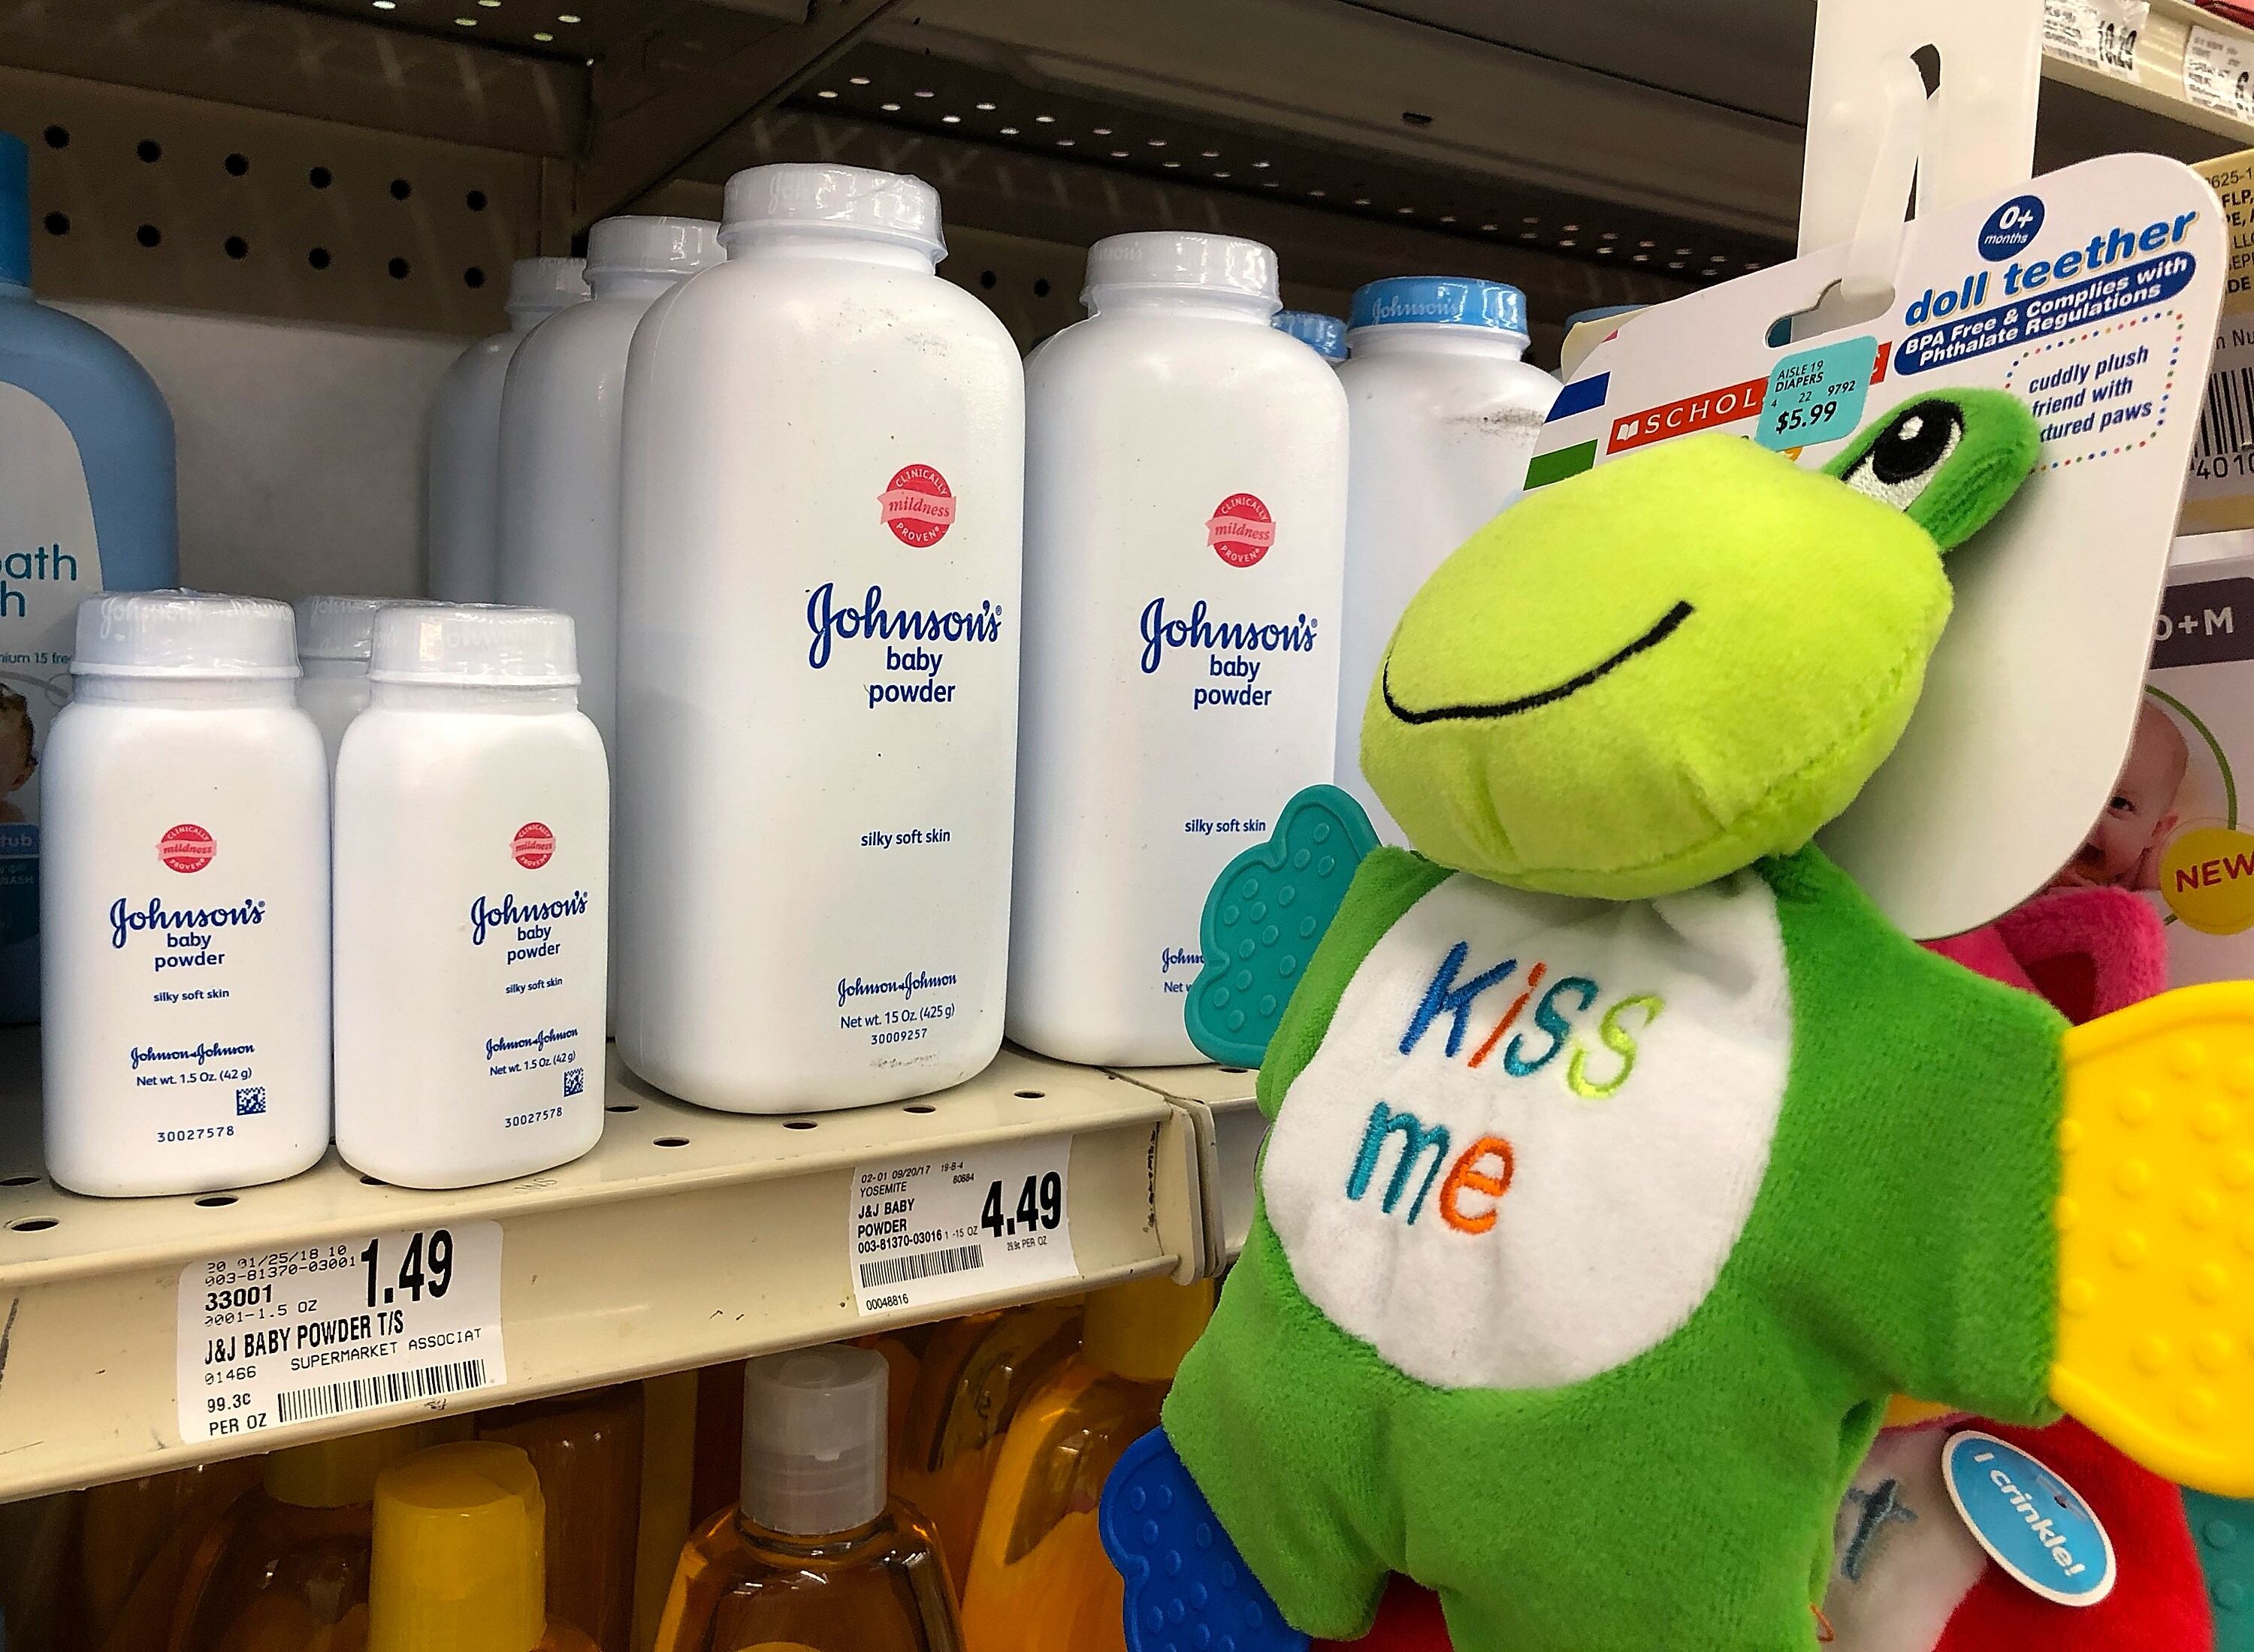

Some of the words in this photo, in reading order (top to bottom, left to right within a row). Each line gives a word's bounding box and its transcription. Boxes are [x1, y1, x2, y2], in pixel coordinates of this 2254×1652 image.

[1999, 206, 2034, 230] 0+
[1984, 231, 2027, 244] months
[1905, 270, 1989, 327] doll
[2003, 210, 2198, 296] teether
[1905, 331, 1945, 355] BPA
[1951, 317, 1996, 347] Free
[2003, 309, 2019, 324] &
[2026, 275, 2130, 319] Complies
[2136, 258, 2188, 284] with
[1919, 330, 2020, 366] Phthalate
[2025, 284, 2162, 340] Regulations
[1777, 364, 1808, 381] AISLE
[1811, 360, 1824, 373] 19
[2029, 363, 2091, 394] cuddly
[2096, 346, 2149, 381] plush
[1771, 399, 1778, 408] 4
[1798, 391, 1812, 403] 22
[1827, 380, 1856, 397] 9792
[1775, 372, 1824, 393] DIAPERS
[2032, 387, 2085, 418] friend
[2092, 376, 2133, 404] with
[1775, 400, 1838, 435] $5.99
[2098, 401, 2153, 433] paws
[896, 468, 948, 496] CLINICALLY
[889, 497, 950, 518] mildness
[1221, 497, 1267, 521] CLINICALLY
[1215, 523, 1271, 541] mildness
[0, 542, 77, 581] ath
[35, 652, 48, 663] 15
[887, 646, 944, 678] baby
[1210, 654, 1261, 683] baby
[869, 678, 956, 709] powder
[1193, 684, 1272, 710] powder
[167, 826, 210, 841] CLINICALLY
[860, 831, 893, 849] silky
[896, 829, 923, 845] soft
[926, 828, 951, 843] skin
[1185, 819, 1213, 835] silky
[1216, 819, 1240, 832] soft
[1243, 819, 1266, 832] skin
[163, 843, 213, 854] mildness
[515, 838, 553, 851] mildness
[167, 932, 212, 950] baby
[518, 925, 551, 941] baby
[155, 951, 225, 971] powder
[507, 942, 560, 965] powder
[153, 992, 179, 1003] silky
[182, 990, 204, 1000] soft
[207, 989, 230, 999] skin
[505, 983, 526, 995] silky
[527, 980, 545, 991] soft
[546, 977, 563, 988] skin
[1164, 981, 1183, 993] Net
[840, 1016, 863, 1029] Net
[865, 1013, 882, 1026] wt.
[884, 1011, 899, 1025] 15
[901, 1009, 917, 1022] Oz.
[920, 1004, 944, 1022] (425
[944, 1002, 956, 1019] g)
[871, 1028, 928, 1045] 30009257
[490, 1066, 507, 1076] Net
[509, 1064, 522, 1072] wt.
[524, 1059, 537, 1070] 1.5
[553, 1053, 567, 1065] (42
[567, 1050, 576, 1063] g)
[136, 1076, 158, 1086] Net
[160, 1075, 177, 1085] wt.
[180, 1073, 197, 1083] 1.5
[199, 1072, 217, 1083] Oz.
[219, 1069, 238, 1082] (42
[240, 1068, 252, 1081] g)
[505, 1107, 563, 1128] 30027578
[157, 1125, 234, 1143] 30027578
[861, 1172, 888, 1184] 02-01
[892, 1165, 931, 1179] 09/20/17
[1346, 1101, 1515, 1235] me
[860, 1181, 908, 1198] YOSEMITE
[858, 1204, 879, 1219] J&J
[884, 1198, 915, 1216] BABY
[981, 1170, 1062, 1238] 4.49
[857, 1219, 908, 1239] POWDER
[858, 1229, 943, 1254] 003-81370-03016
[967, 1225, 978, 1236] OZ
[1022, 1237, 1036, 1248] PER
[1037, 1235, 1047, 1246] OZ
[237, 1249, 319, 1269] 01/25/18
[330, 1245, 347, 1257] 10
[361, 1229, 454, 1308] 1.49
[205, 1256, 355, 1287] 003-81370-03001
[205, 1284, 272, 1311] 33001
[298, 1299, 318, 1313] OZ
[866, 1293, 909, 1311] 00048816
[205, 1339, 237, 1366] J&J
[244, 1326, 291, 1359] BABY
[297, 1314, 371, 1350] POWDER
[377, 1309, 405, 1336] T/S
[204, 1366, 257, 1386] 01466
[290, 1341, 398, 1372] SUPERMARKET
[409, 1328, 482, 1351] ASSOCIAT
[209, 1418, 240, 1436] PER
[246, 1412, 268, 1430] OZ
[1974, 1451, 1994, 1463] I
[1990, 1469, 2086, 1577] crinkle!
